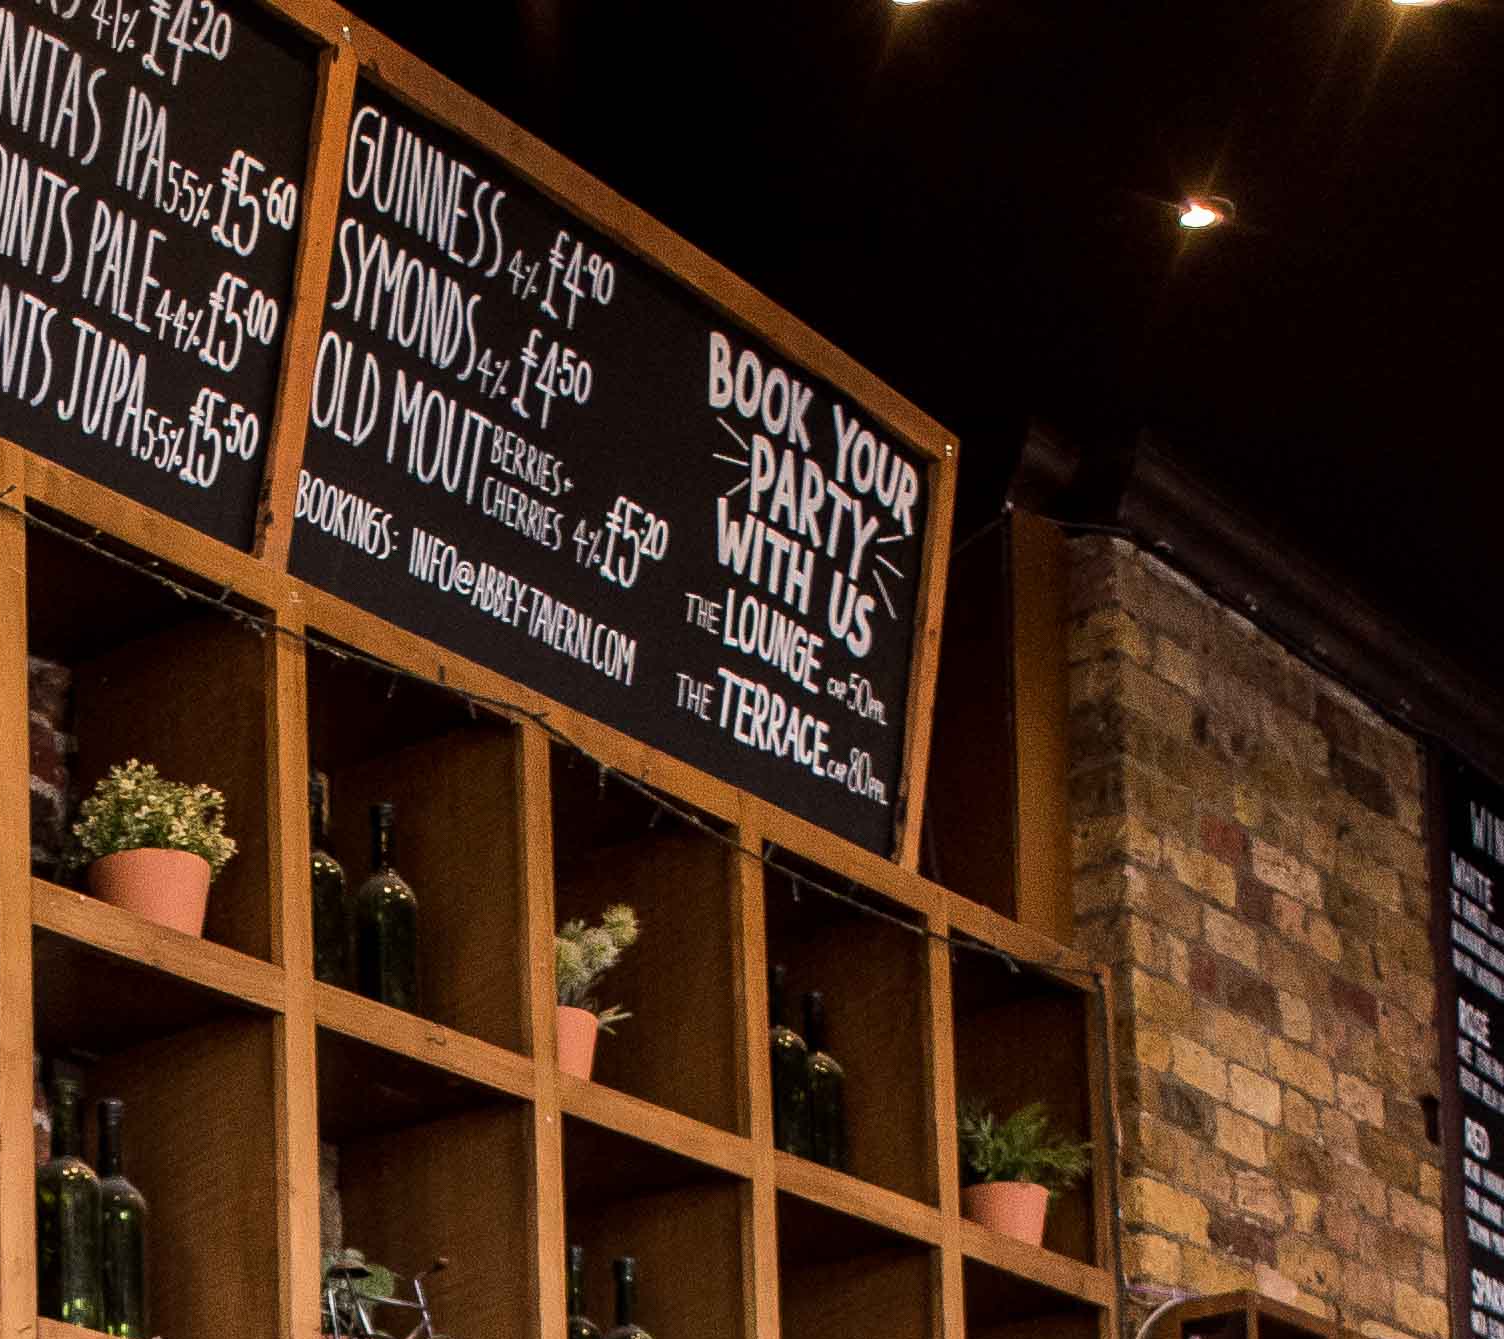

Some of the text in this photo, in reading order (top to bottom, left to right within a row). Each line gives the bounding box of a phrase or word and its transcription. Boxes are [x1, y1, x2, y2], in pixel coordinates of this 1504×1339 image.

[116, 86, 167, 208] IPA
[163, 160, 213, 227] 5.5%
[211, 149, 297, 256] £5.60
[346, 105, 615, 330] GUINNESS 4% £4.90
[82, 200, 167, 332] PALE
[199, 272, 279, 372] £5.00
[332, 217, 592, 430] SYMONDS 4% £4.50
[57, 317, 147, 457] JUPA
[179, 388, 259, 488] £5.50
[311, 331, 492, 504] OLD MOUT
[708, 331, 919, 536] BOOK YOUR
[294, 470, 400, 560] BOOKINGS:
[482, 476, 669, 588] CHERRIES 4% £5.20
[717, 498, 876, 658] WITH US
[750, 433, 880, 581] PARTY
[676, 672, 716, 722] THE
[717, 667, 830, 777] TERRACE
[685, 593, 722, 635] THE
[723, 588, 824, 695] LOUNGE
